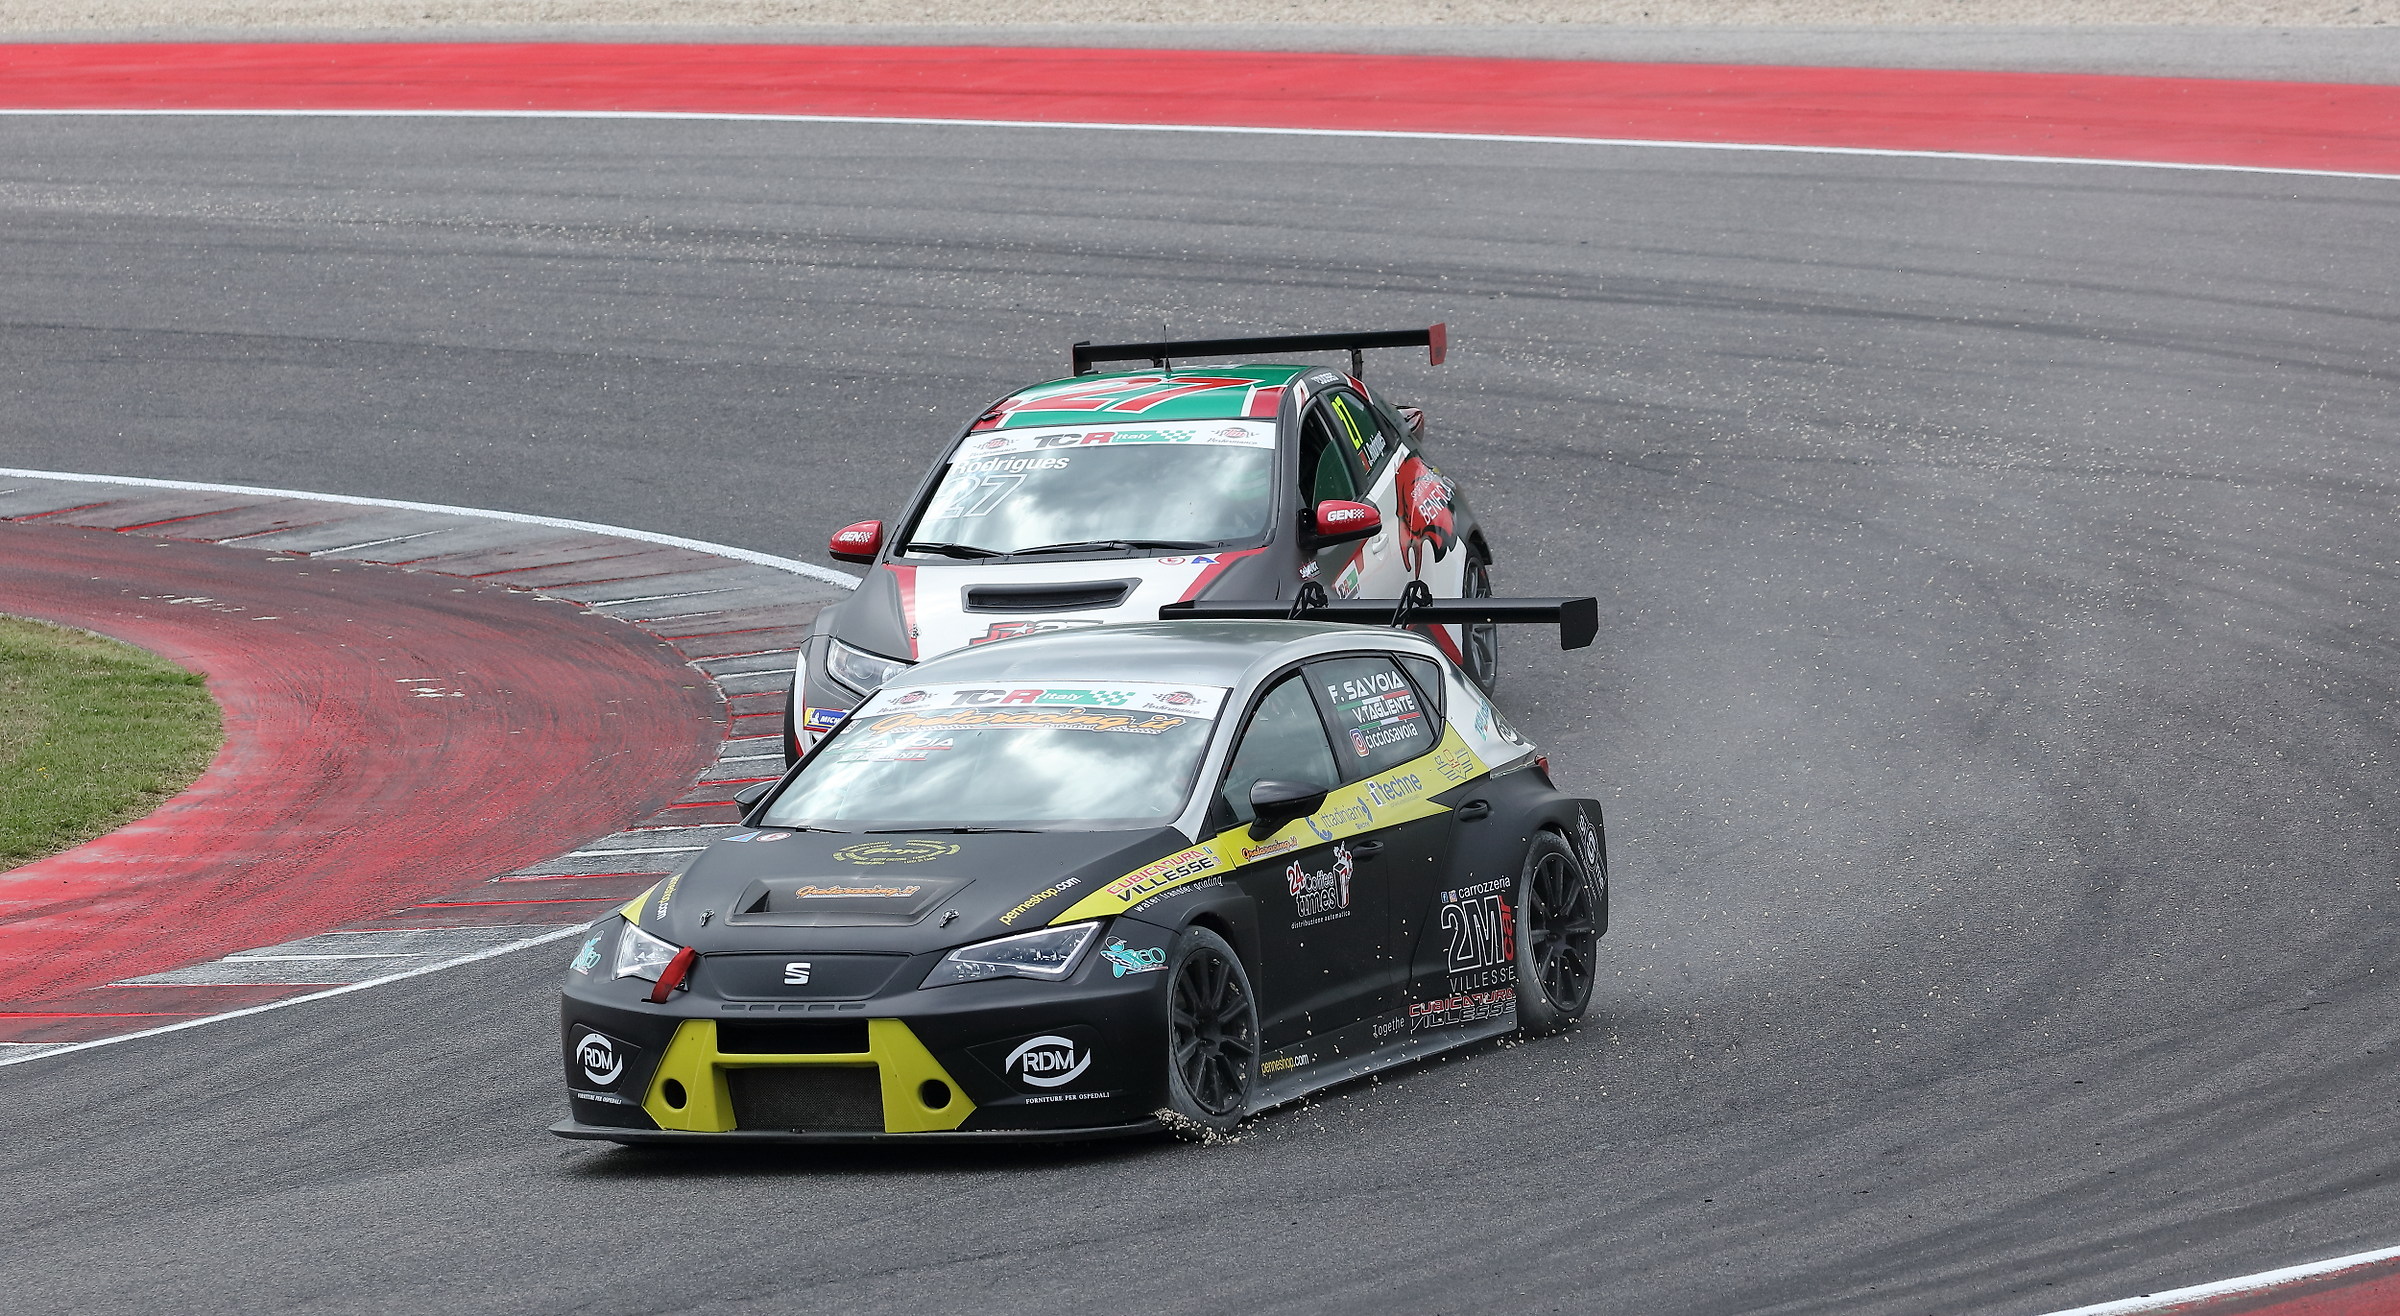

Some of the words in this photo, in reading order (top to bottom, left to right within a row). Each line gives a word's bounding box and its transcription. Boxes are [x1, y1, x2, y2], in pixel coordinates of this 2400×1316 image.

[1010, 376, 1266, 414] 27
[1033, 431, 1116, 448] TCR
[1116, 431, 1153, 442] Italy
[951, 455, 1070, 475] Rodrigues
[1327, 508, 1353, 522] GEN
[1419, 481, 1455, 525] BENFICA
[839, 531, 861, 542] GEN
[952, 689, 1043, 705] TCR
[1043, 692, 1084, 702] Italy
[1327, 684, 1345, 704] F.
[1343, 670, 1405, 700] SAVOIA
[1365, 719, 1418, 749] cicciosavoia
[1117, 857, 1215, 902] VILLESSE
[1286, 860, 1306, 896] 24
[1458, 876, 1511, 899] carrozzeria
[998, 876, 1082, 926] penneshop.com
[1134, 897, 1160, 913] water
[1441, 895, 1505, 973] 2M
[1499, 895, 1514, 961] car
[1450, 965, 1515, 992] VILLESSE
[584, 1046, 613, 1070] RDM
[1023, 1049, 1075, 1072] RDM
[1026, 1096, 1064, 1105] FORNITURE
[1078, 1092, 1110, 1100] OSPEDALI
